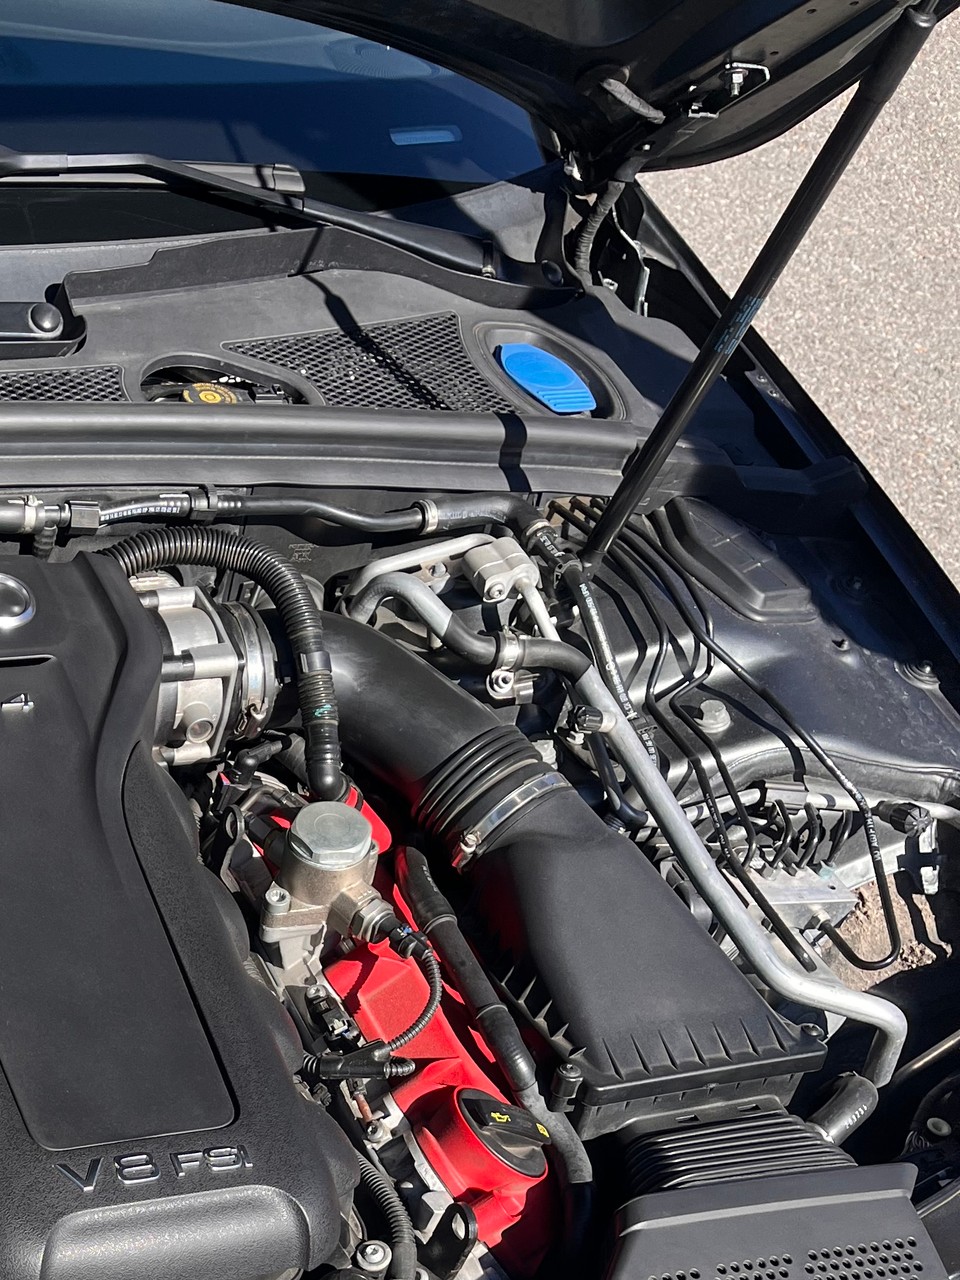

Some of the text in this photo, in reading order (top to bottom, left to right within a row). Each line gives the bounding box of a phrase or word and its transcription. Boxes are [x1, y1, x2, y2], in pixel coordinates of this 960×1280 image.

[0, 692, 34, 713] 4
[55, 1144, 254, 1192] V8 FSI
